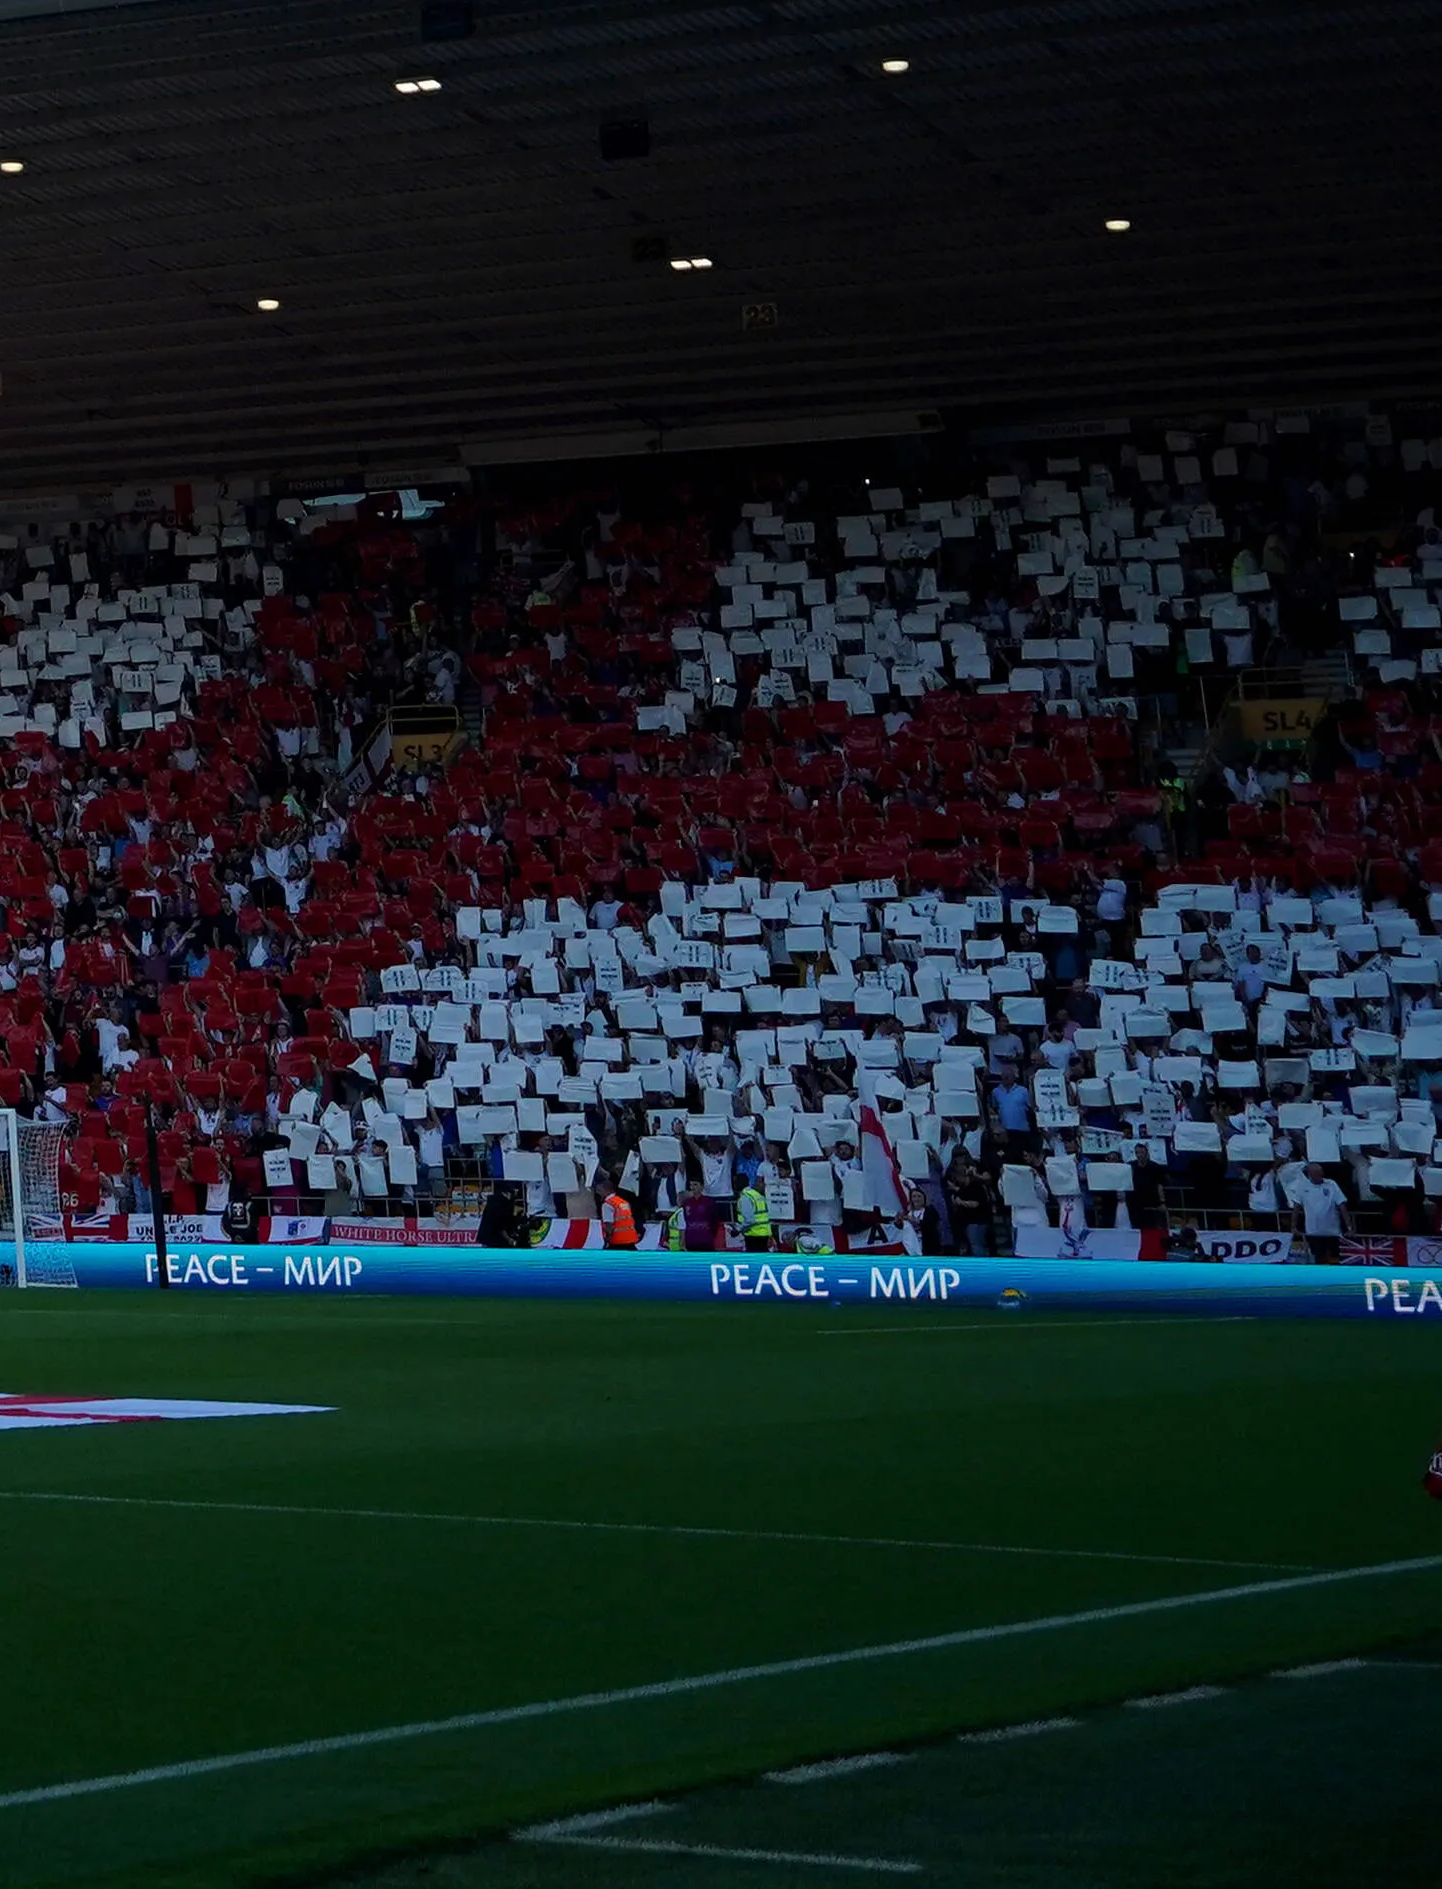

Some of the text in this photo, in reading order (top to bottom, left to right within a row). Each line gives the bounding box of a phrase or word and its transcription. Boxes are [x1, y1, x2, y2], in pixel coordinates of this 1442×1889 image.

[1263, 711, 1311, 732] SL4
[145, 1254, 250, 1285] PEACE
[284, 1256, 363, 1287] МИР
[710, 1264, 830, 1297] PEACE
[870, 1267, 960, 1300] МИР
